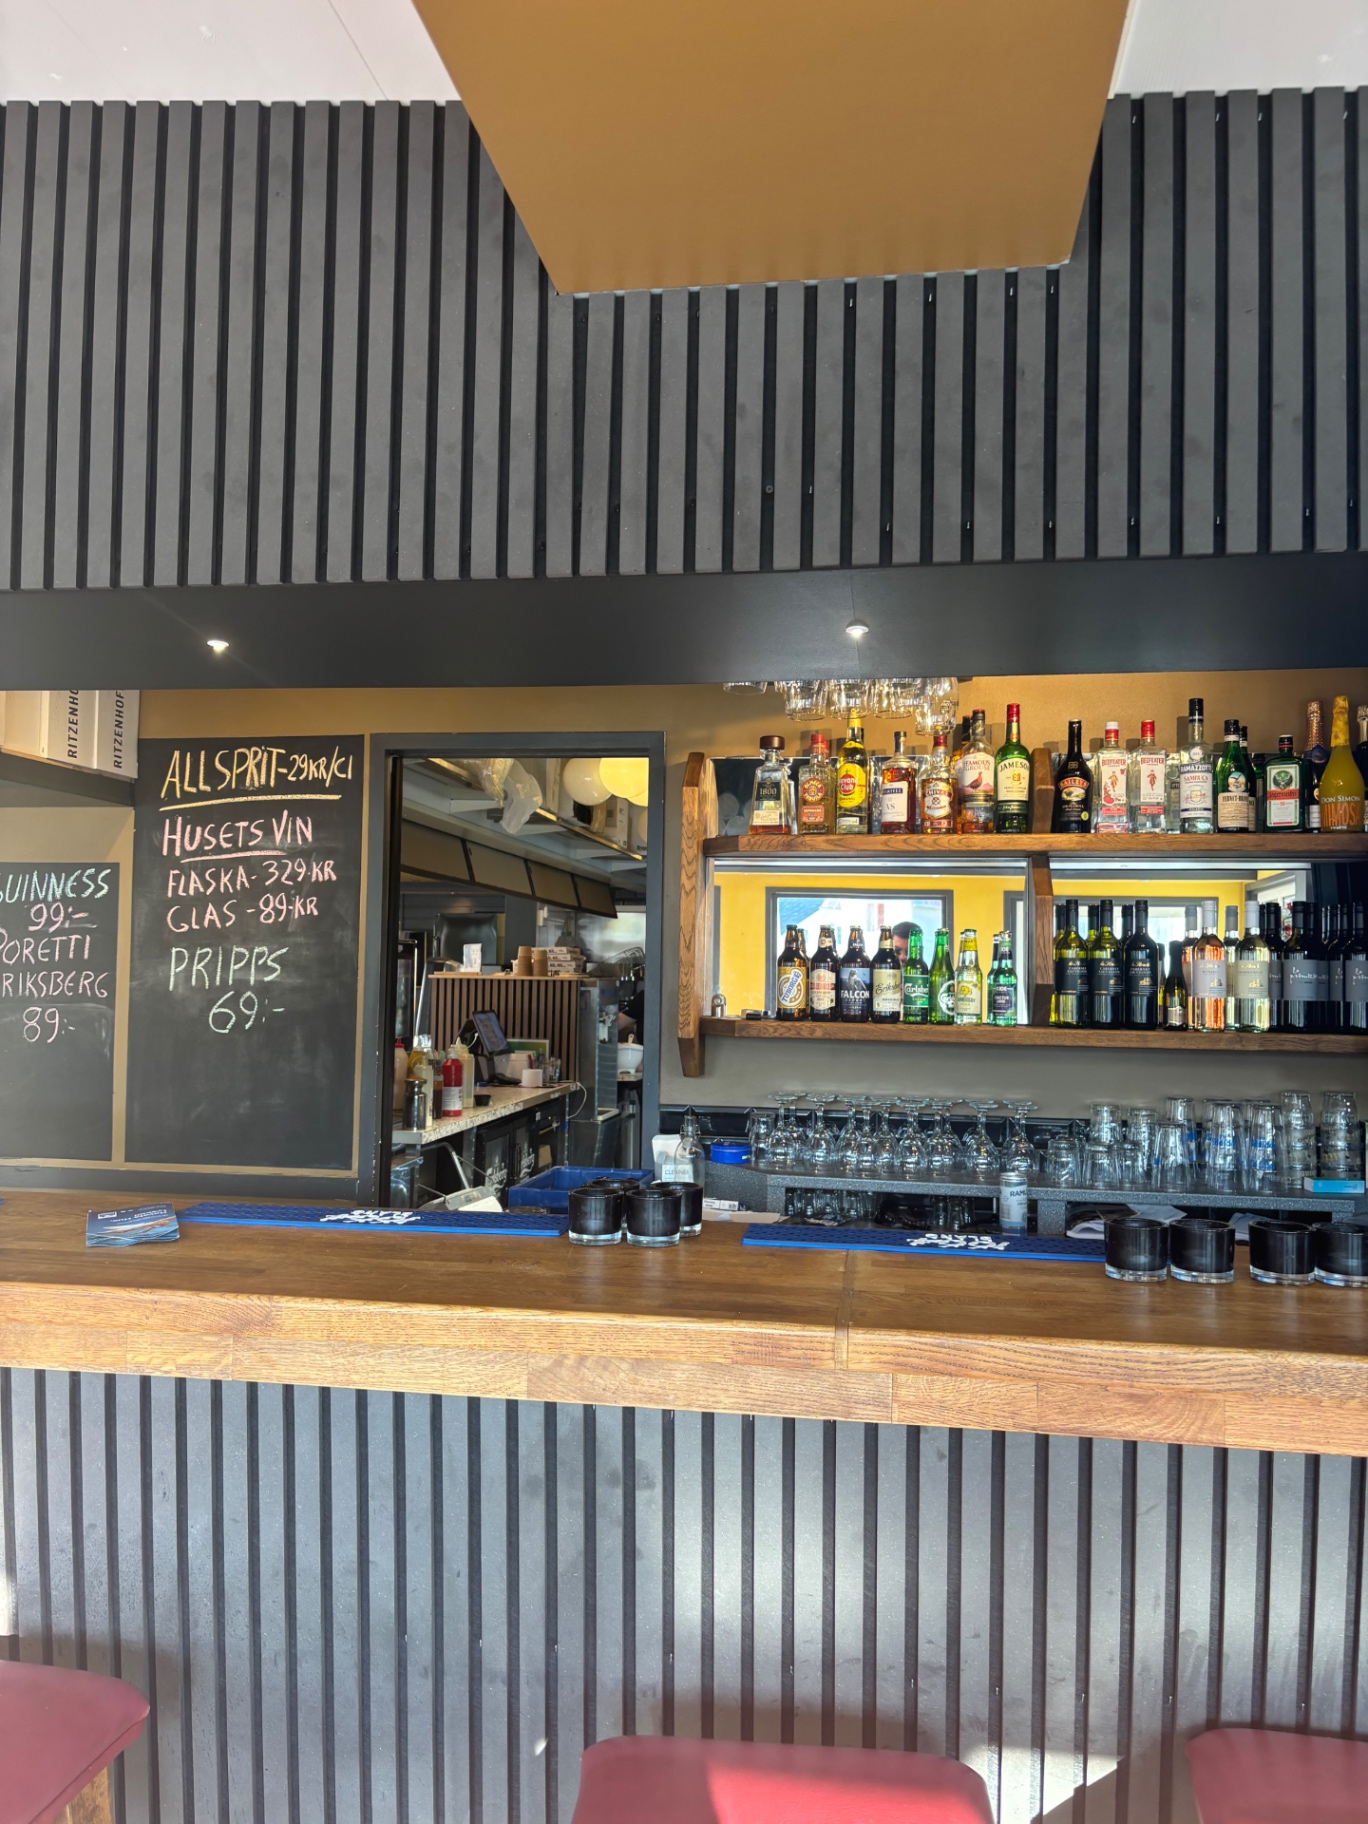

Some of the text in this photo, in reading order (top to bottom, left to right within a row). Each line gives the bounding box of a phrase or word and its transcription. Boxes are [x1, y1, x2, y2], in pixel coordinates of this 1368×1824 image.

[113, 690, 125, 769] RITZENHOF
[964, 759, 991, 767] FAMOUS
[1101, 758, 1127, 767] BEEFEATER
[1140, 757, 1165, 765] BEEFEATER
[160, 750, 211, 799] ALL
[759, 787, 777, 796] 1800
[841, 783, 854, 791] Club
[886, 802, 896, 811] VS
[162, 809, 313, 857] HUSETS VIN
[167, 900, 237, 933] GLAS
[169, 945, 289, 991] PRIPPS
[2, 970, 109, 999] RIKSBERG
[782, 971, 802, 1002] TUBORG
[840, 989, 870, 999] FALCON
